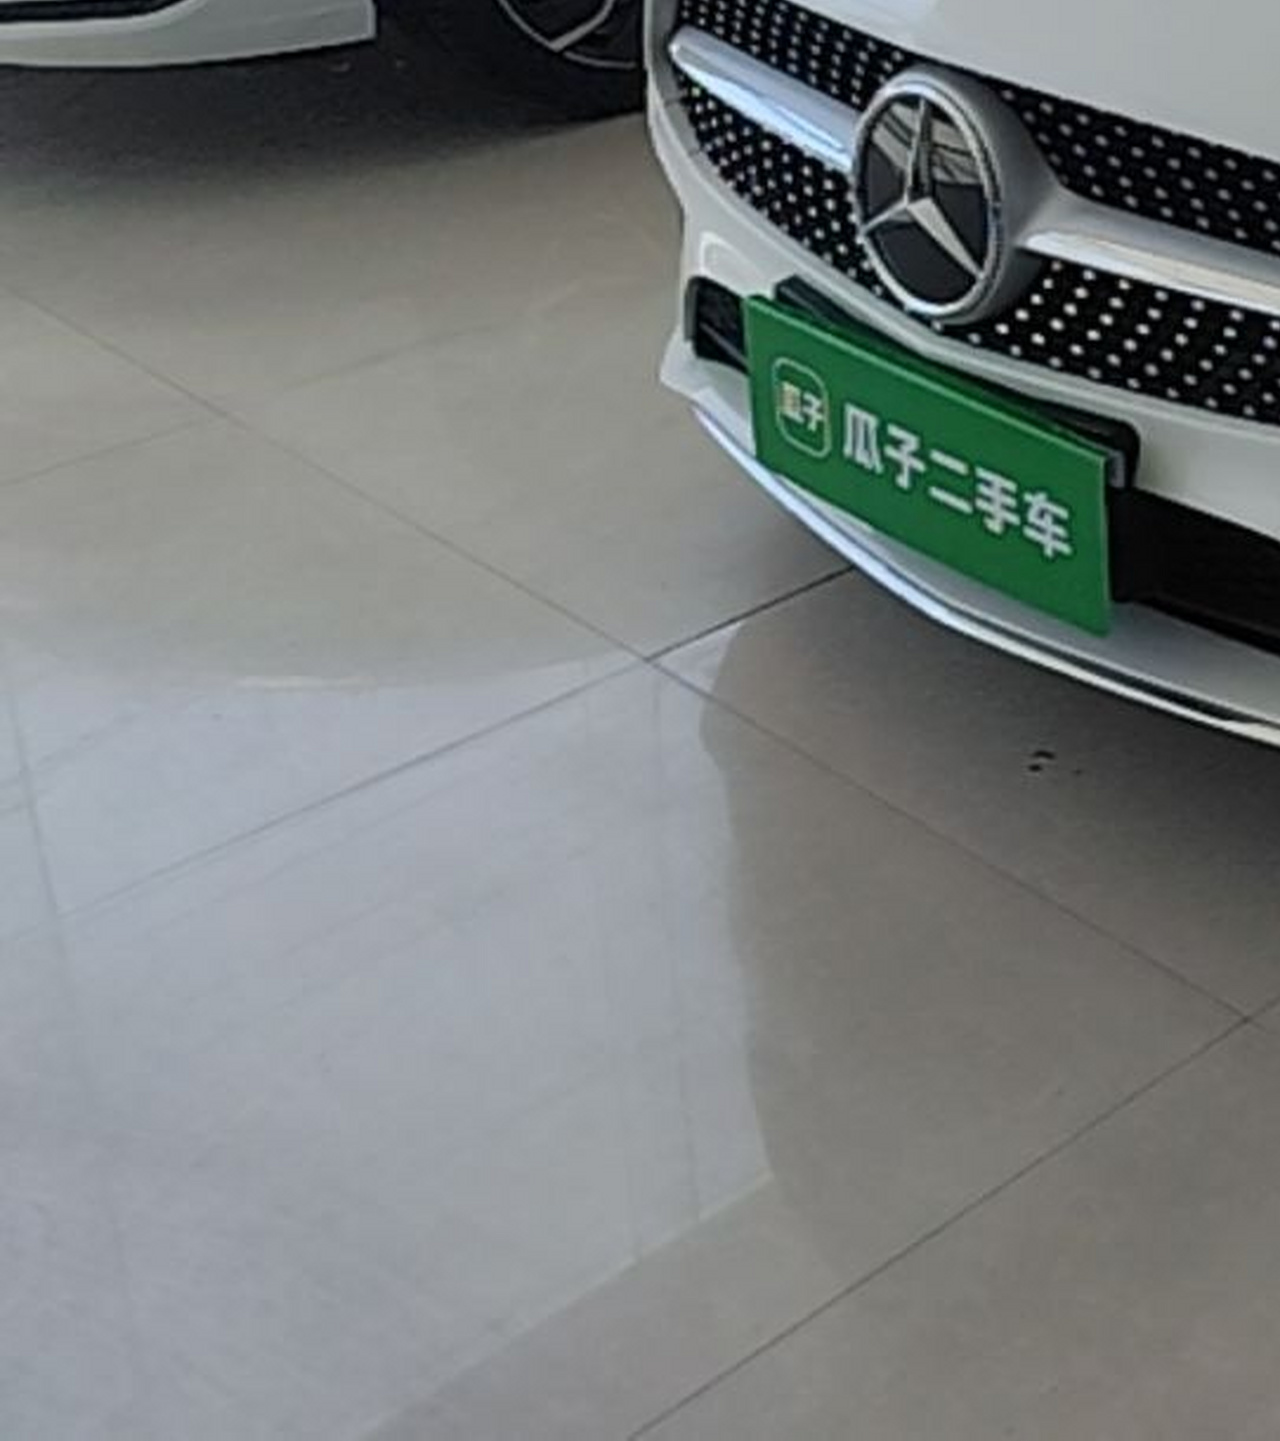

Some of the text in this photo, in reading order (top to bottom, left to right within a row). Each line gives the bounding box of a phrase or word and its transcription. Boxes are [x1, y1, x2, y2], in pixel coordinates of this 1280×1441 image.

[843, 402, 1073, 558] 瓜子二手车
